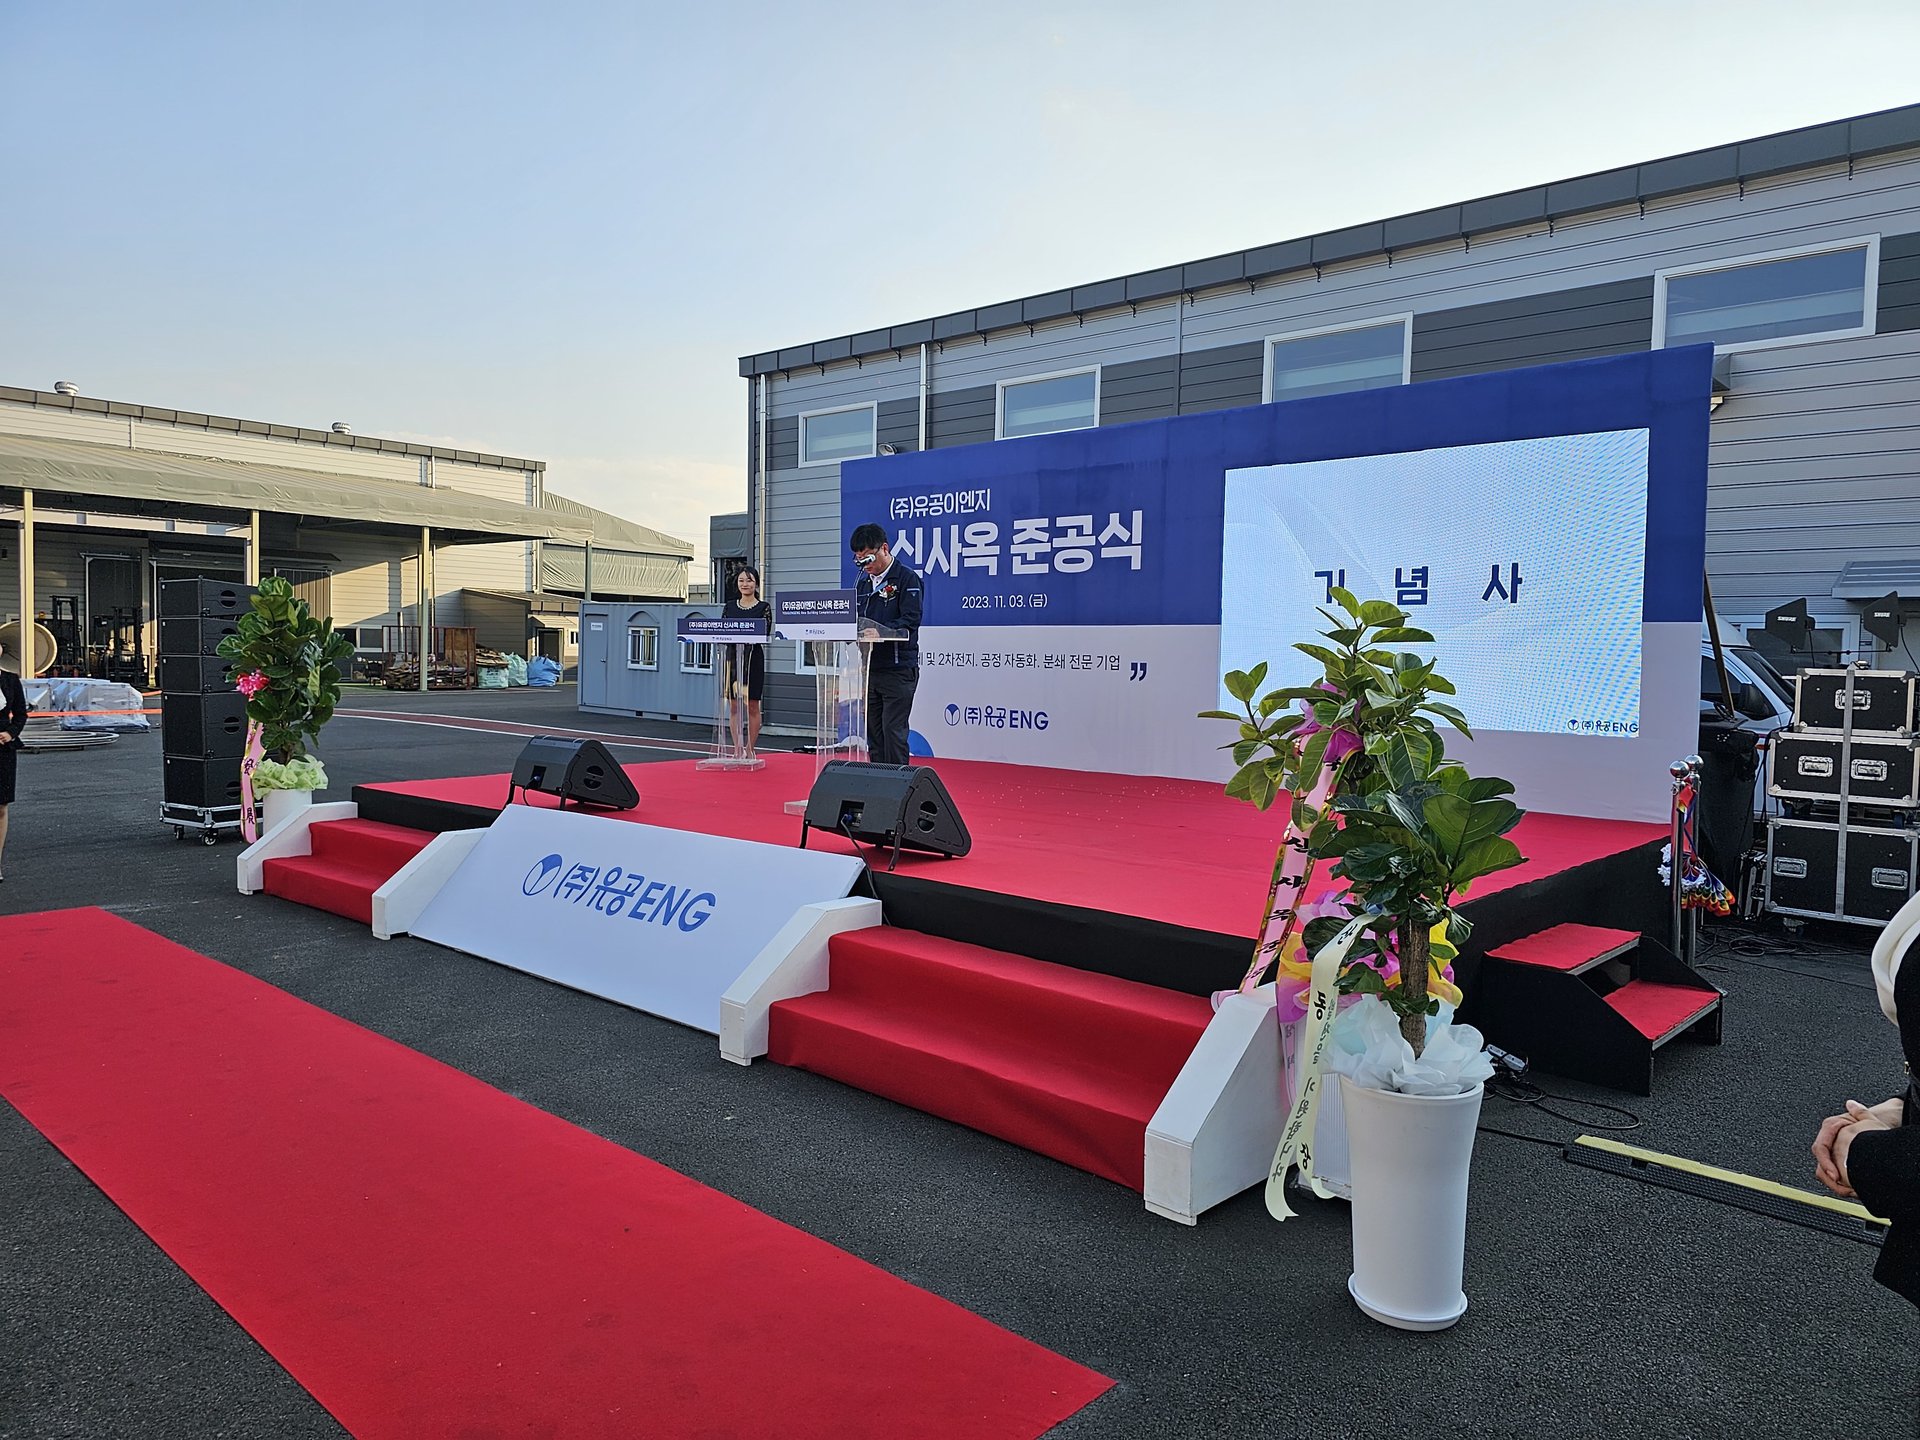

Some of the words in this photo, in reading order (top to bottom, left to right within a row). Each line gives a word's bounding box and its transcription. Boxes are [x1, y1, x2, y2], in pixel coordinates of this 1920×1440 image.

[889, 488, 991, 520] (주)유공이엔지
[1010, 509, 1144, 575] 준공식
[961, 595, 992, 609] 2023.
[1008, 594, 1026, 608] 03.
[1028, 593, 1048, 608] (금)
[926, 651, 936, 667] 및
[981, 653, 1002, 669] 공정
[1043, 653, 1066, 670] 분쇄
[1069, 654, 1093, 671] 전문
[1096, 655, 1121, 671] 기업
